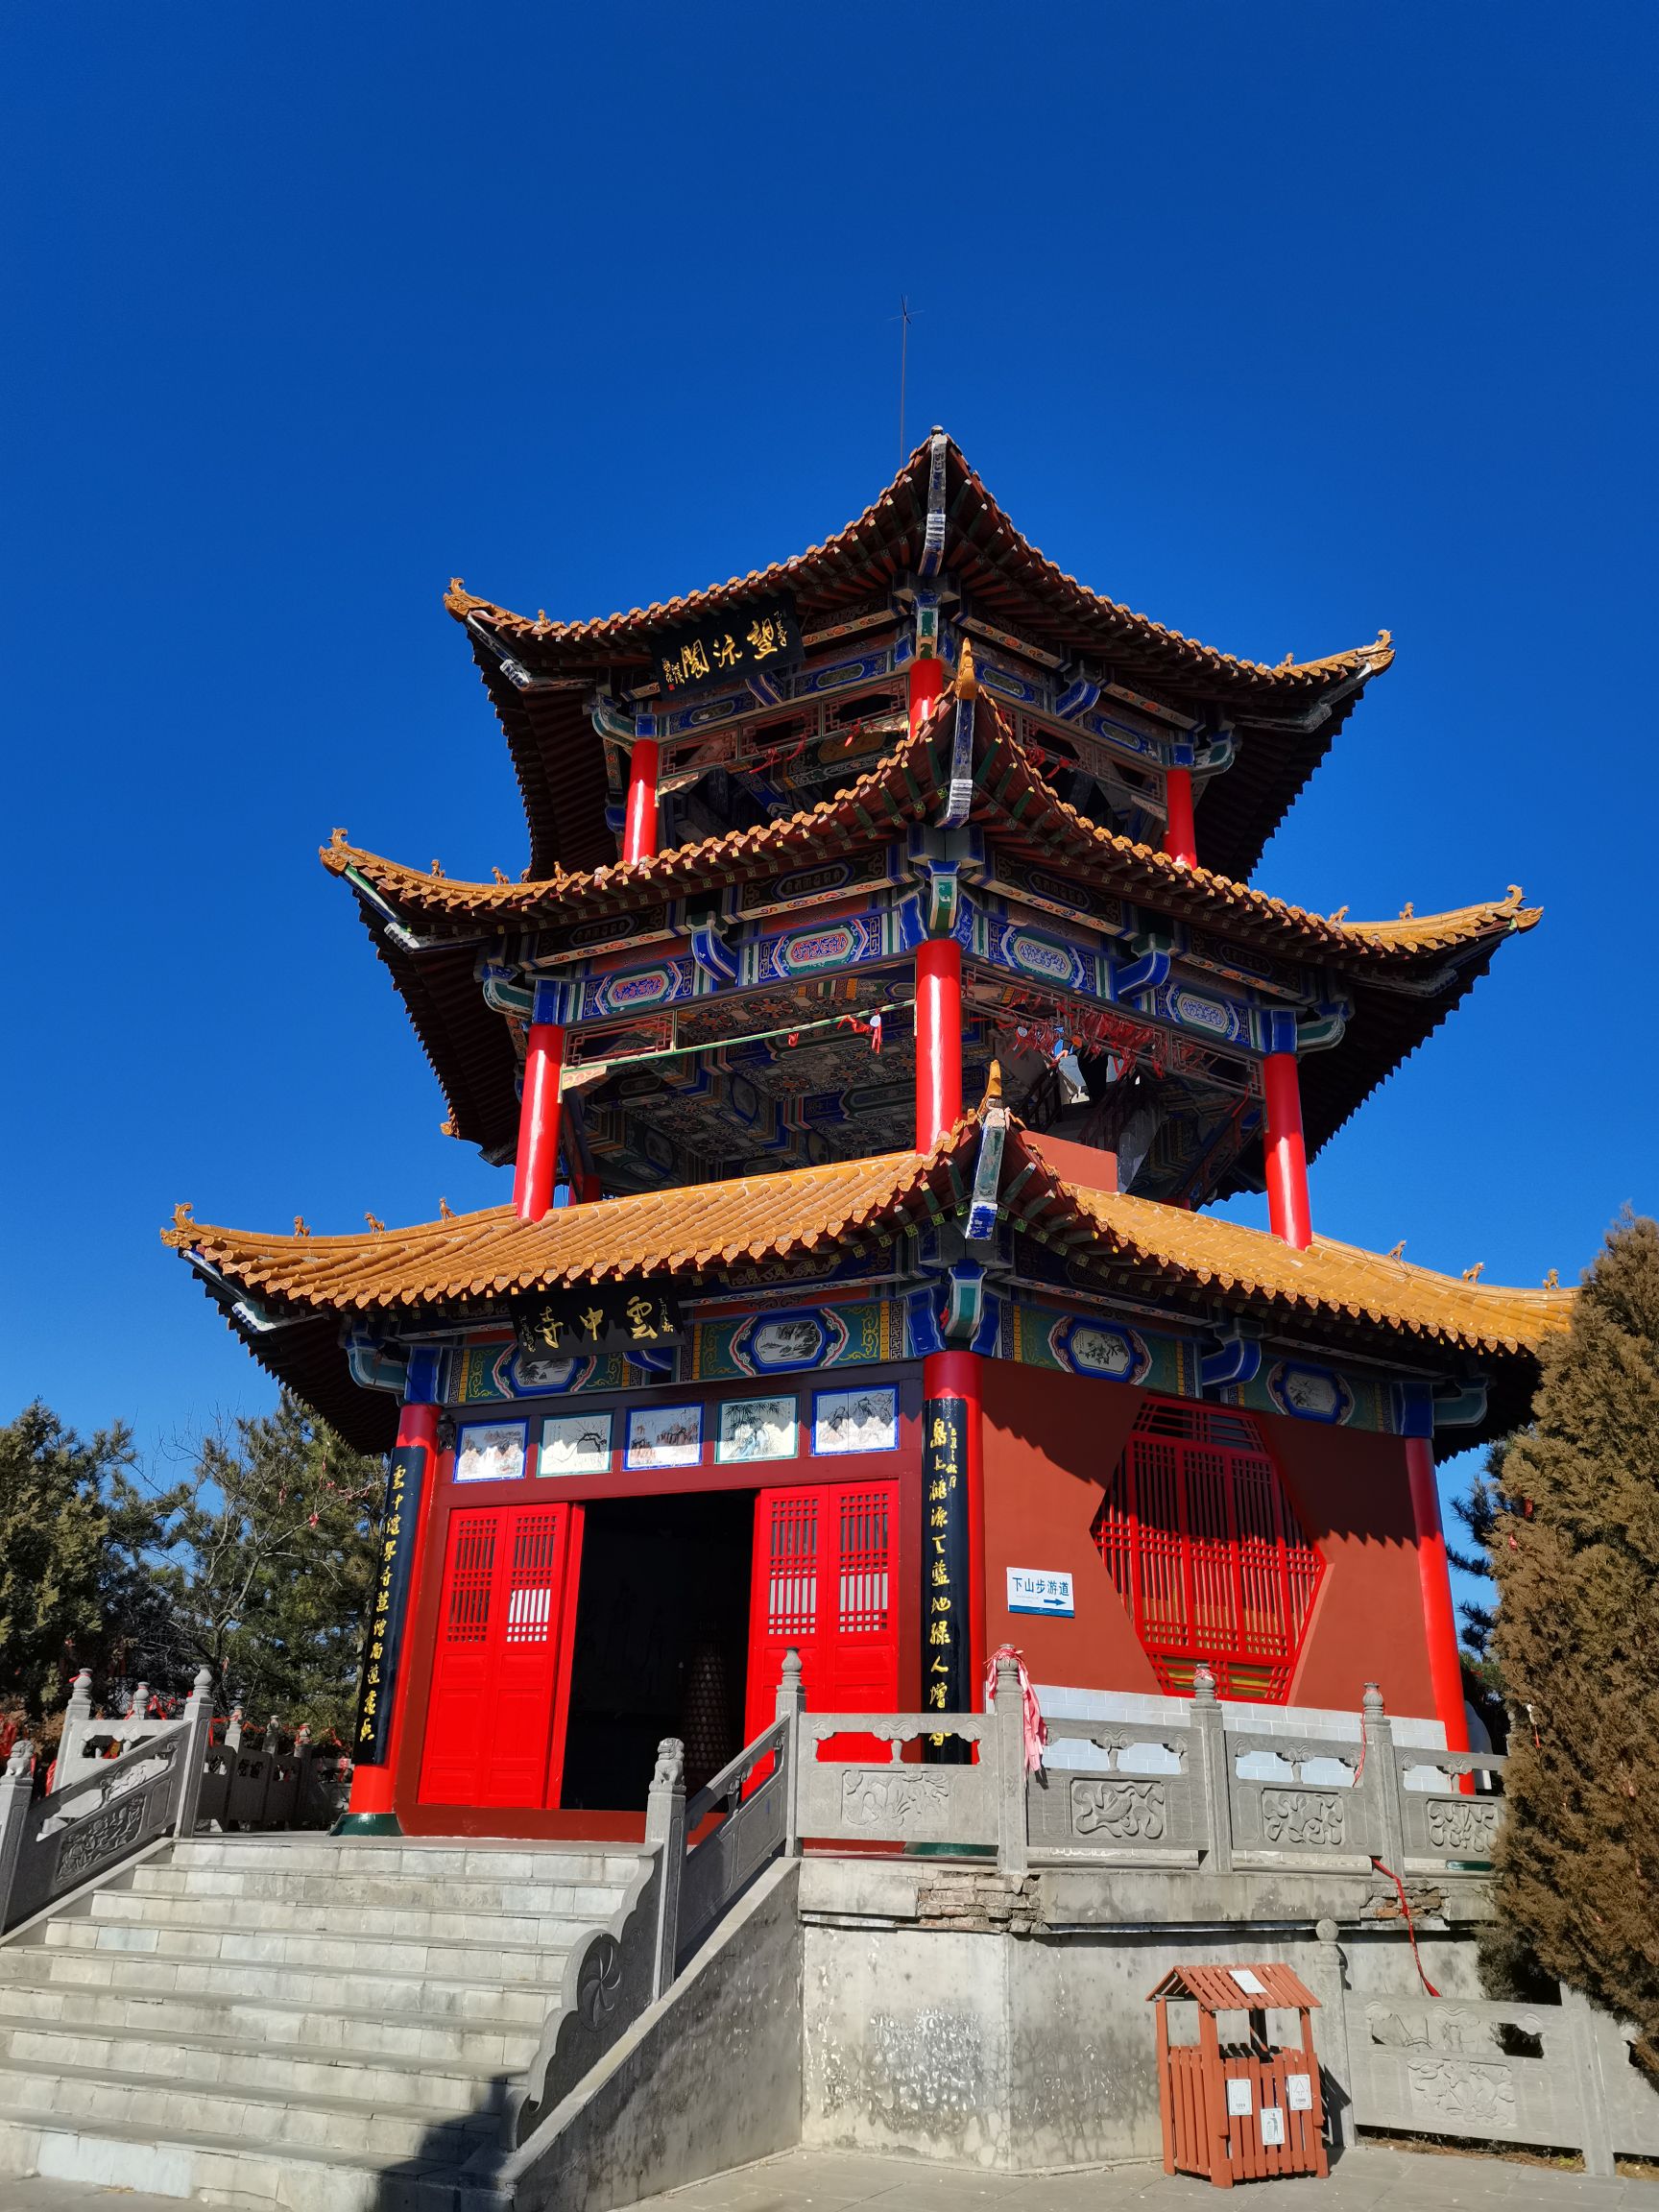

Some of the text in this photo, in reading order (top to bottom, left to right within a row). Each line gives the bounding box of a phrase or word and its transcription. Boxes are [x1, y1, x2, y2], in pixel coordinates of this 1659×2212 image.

[1012, 1576, 1070, 1597] 下山步游道
